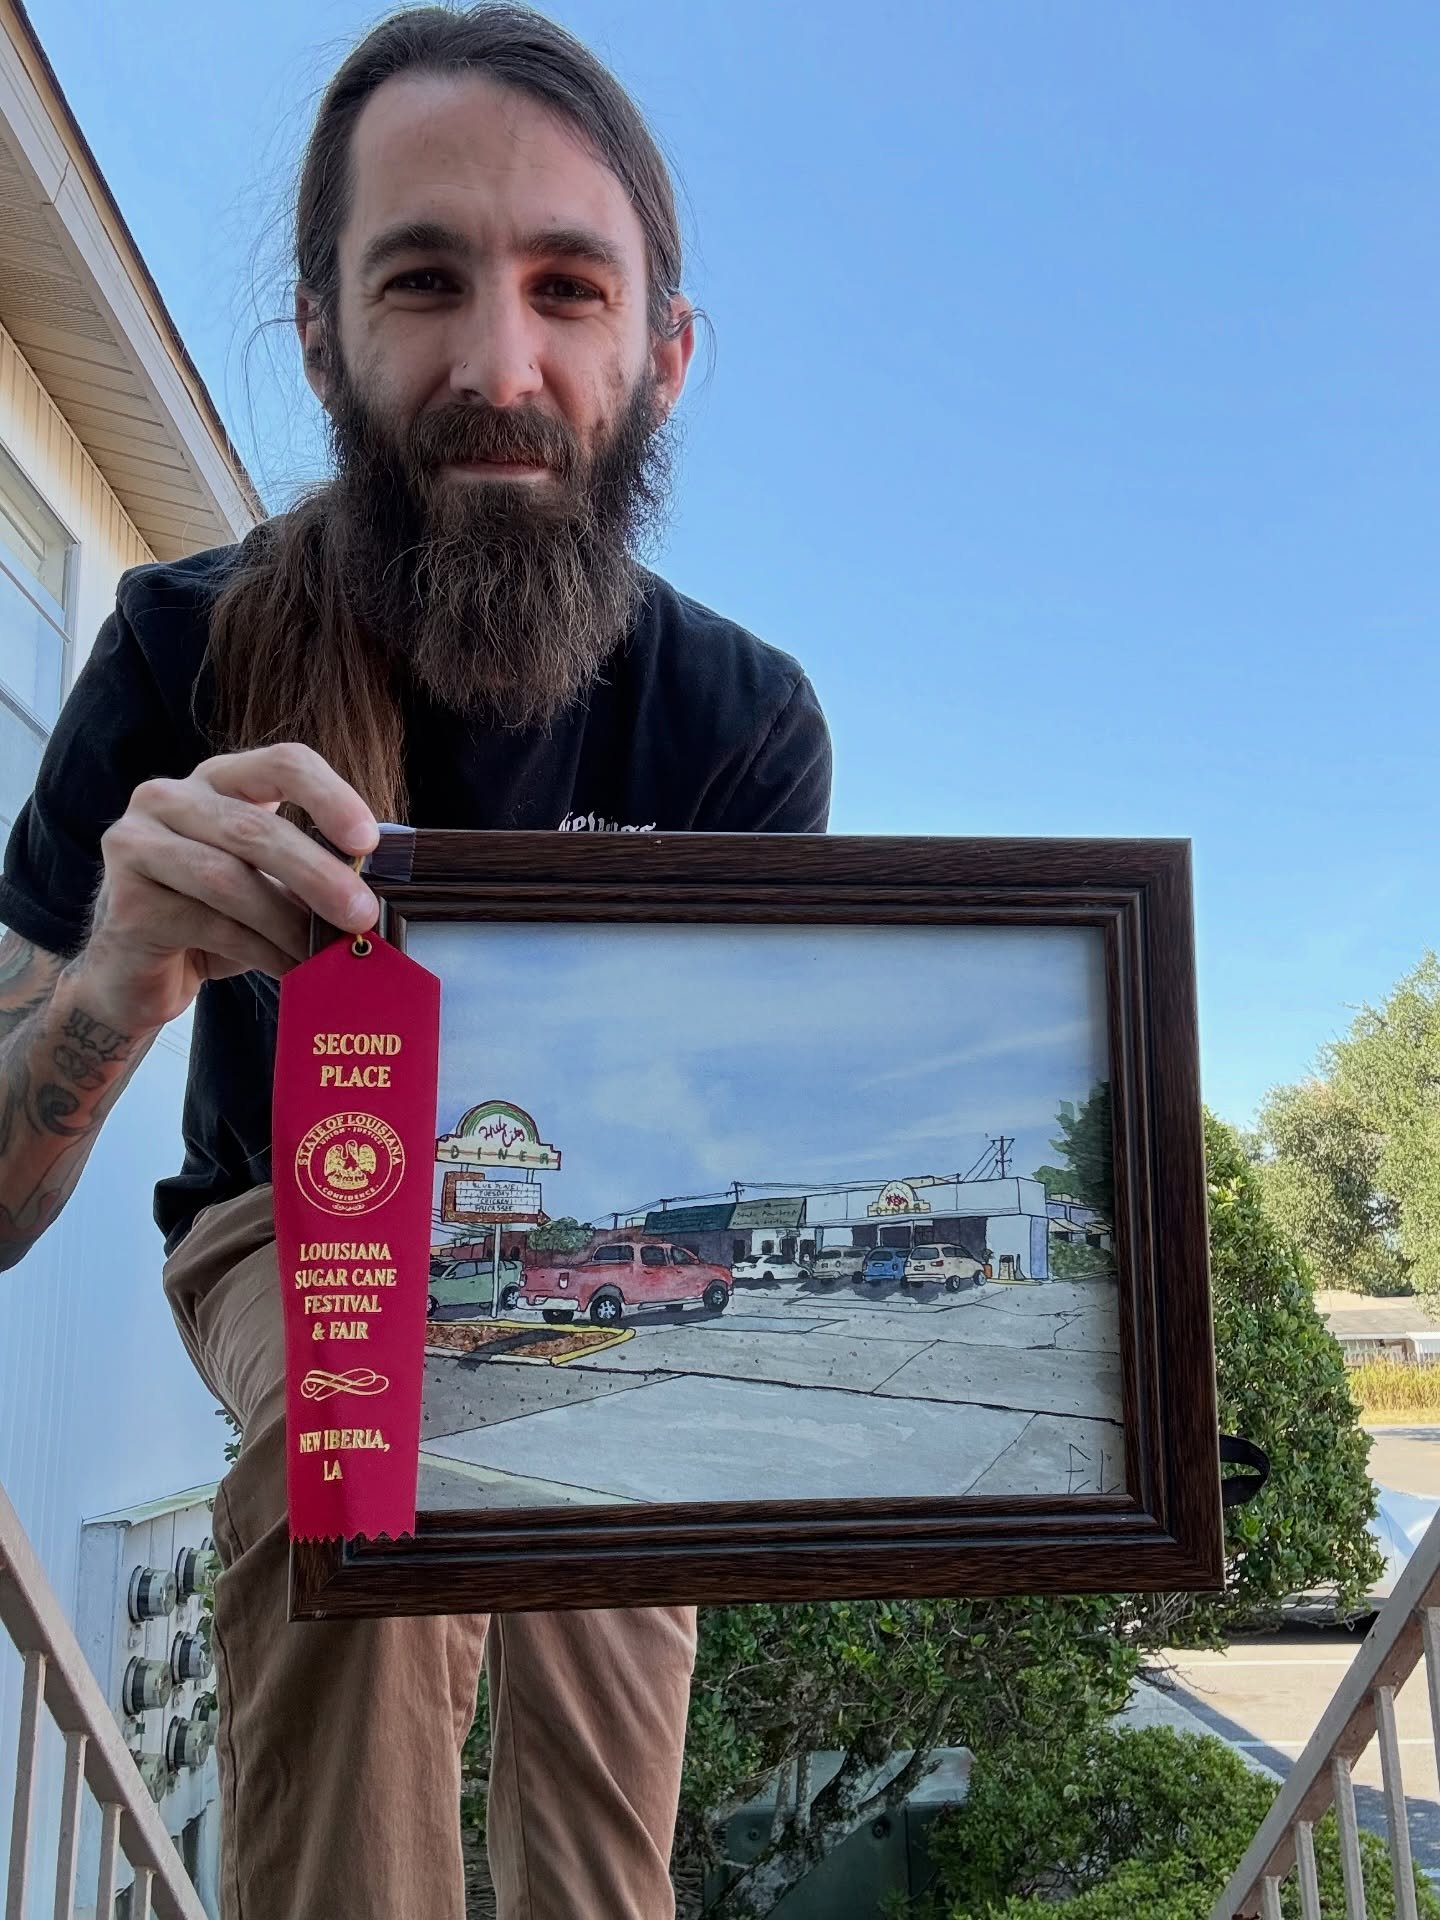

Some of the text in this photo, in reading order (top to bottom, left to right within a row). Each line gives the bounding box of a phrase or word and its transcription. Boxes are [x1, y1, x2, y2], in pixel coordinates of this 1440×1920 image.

[312, 1033, 402, 1056] SECOND
[319, 1065, 391, 1088] PLACE
[297, 1114, 404, 1166] STATE OF LOUISIANA
[320, 1126, 384, 1146] UNION JUSTICE
[451, 1145, 549, 1165] DINER
[321, 1187, 376, 1201] CONFIDENCE
[299, 1242, 392, 1262] LOUISIANA
[294, 1268, 398, 1290] SUGAR CANE
[304, 1294, 383, 1315] FESTIVAL
[311, 1321, 369, 1341] & FAIR
[299, 1428, 391, 1454] NEW IBERIA,
[323, 1459, 343, 1481] LA
